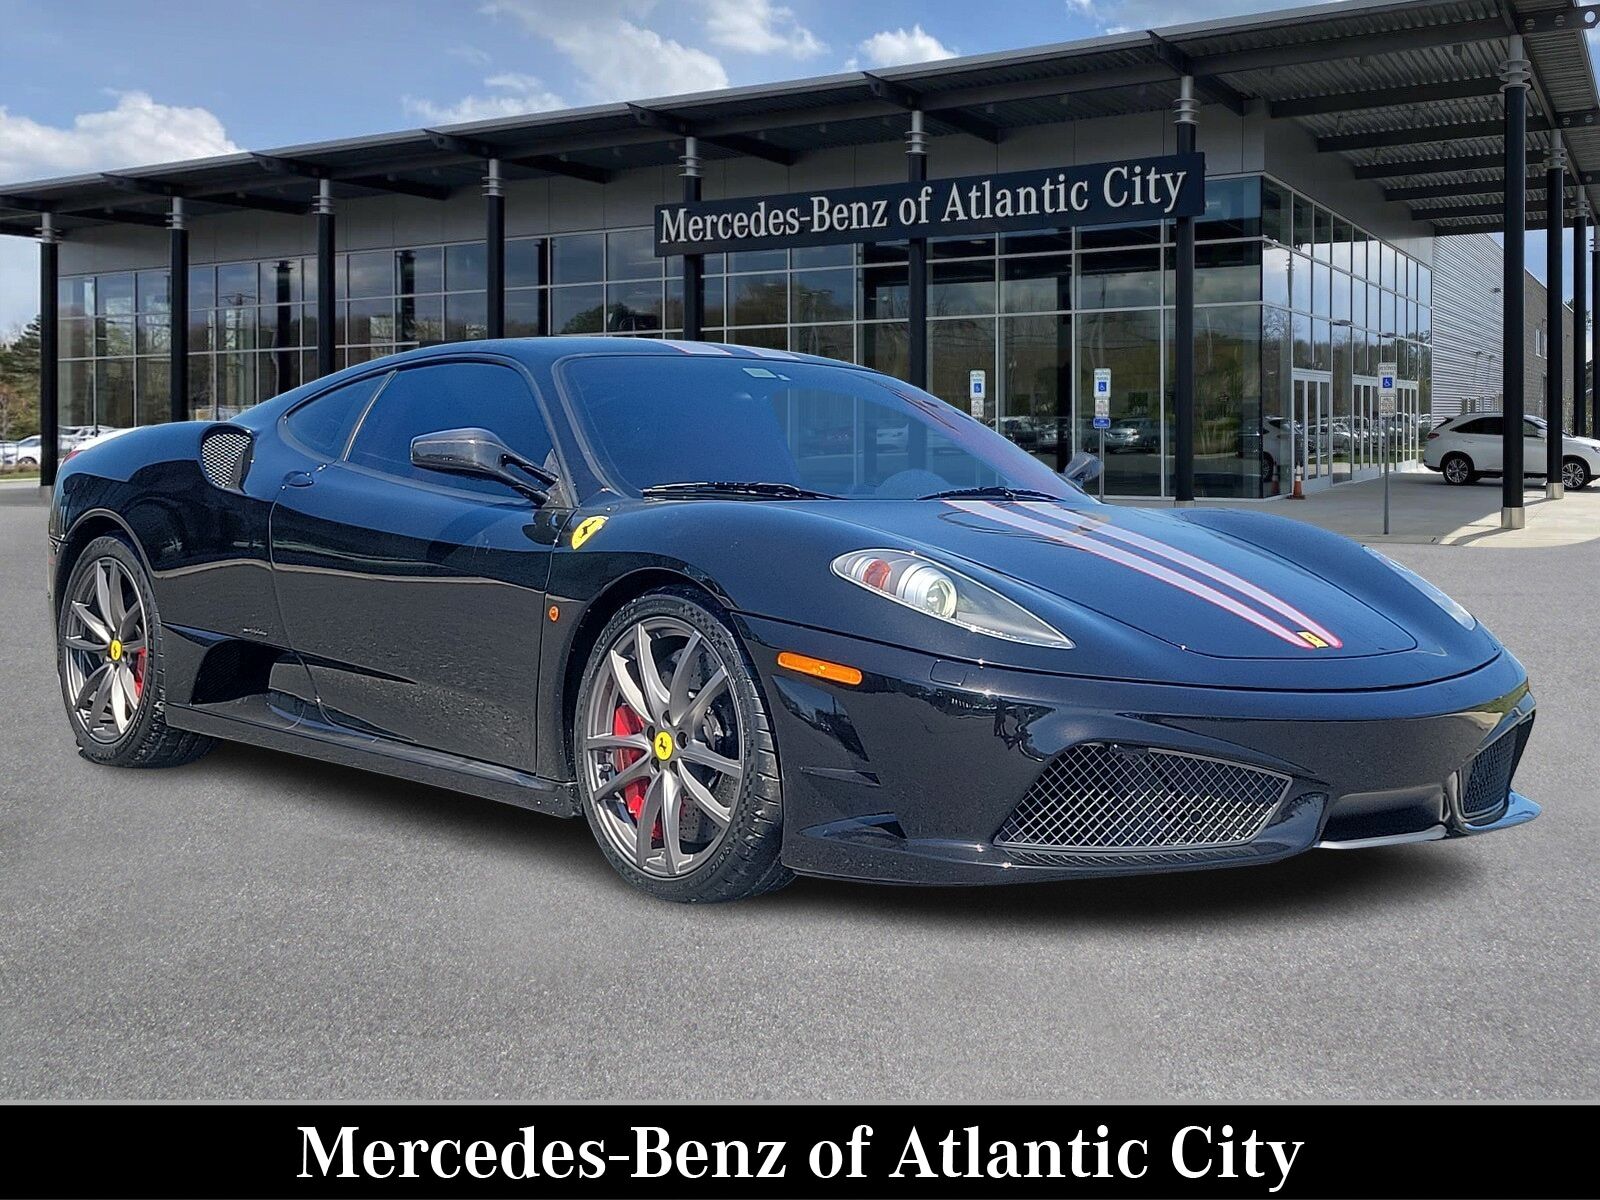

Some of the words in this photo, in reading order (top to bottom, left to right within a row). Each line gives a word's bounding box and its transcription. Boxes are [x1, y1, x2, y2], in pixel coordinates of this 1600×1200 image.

[659, 199, 888, 244] Mercedes-Benz
[898, 186, 933, 225] of
[940, 172, 1089, 223] Atlantic
[1102, 162, 1188, 214] City
